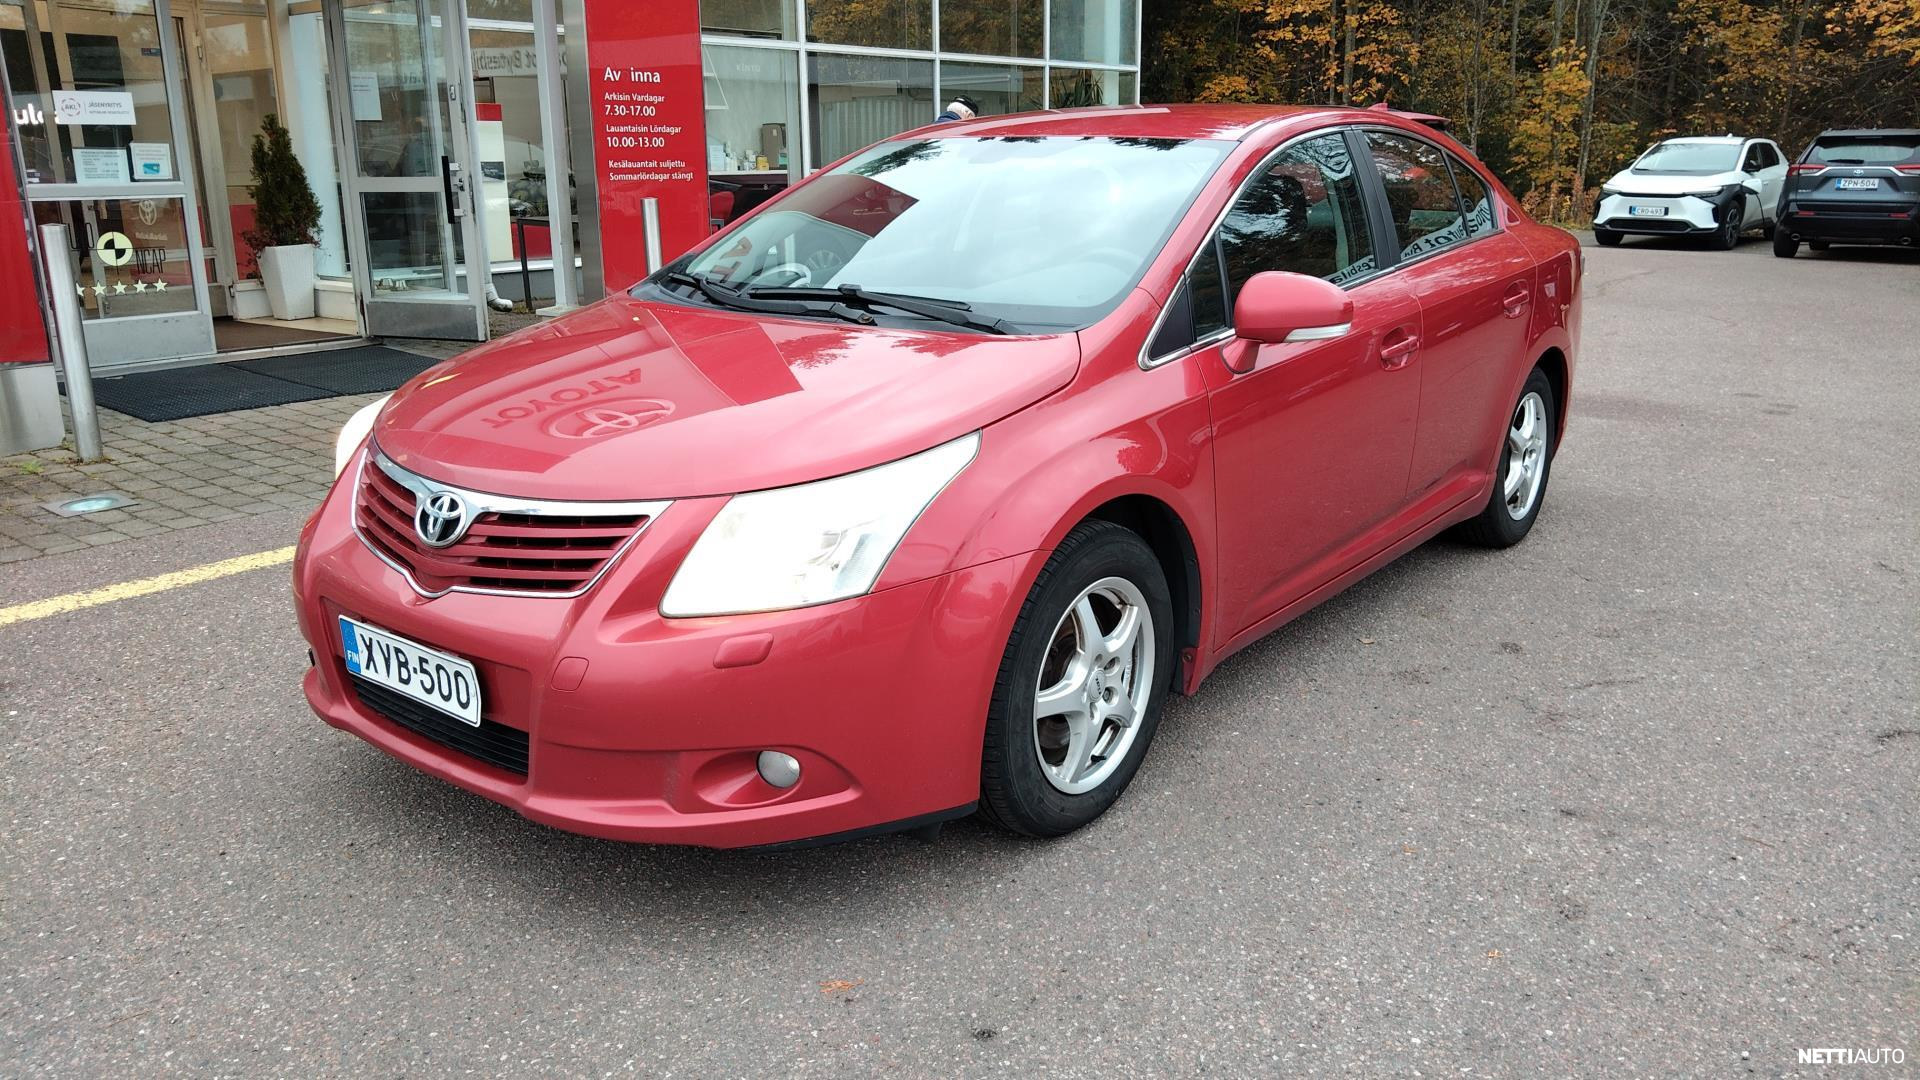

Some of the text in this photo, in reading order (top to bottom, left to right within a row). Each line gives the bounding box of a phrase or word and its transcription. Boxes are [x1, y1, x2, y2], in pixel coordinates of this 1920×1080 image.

[604, 92, 665, 104] Arkisin Vardagar
[604, 104, 656, 117] 7.30-17.00
[606, 124, 682, 135] Lauantaisin Lördagar
[606, 136, 665, 148] 10.00-13.00
[608, 160, 686, 169] Kesälauantait suljettu
[609, 172, 694, 182] Sommarlördagar stängt
[1842, 178, 1877, 187] ZPN-504
[135, 248, 167, 275] NCAP
[347, 650, 360, 665] FIN
[360, 633, 471, 710] XVB-500
